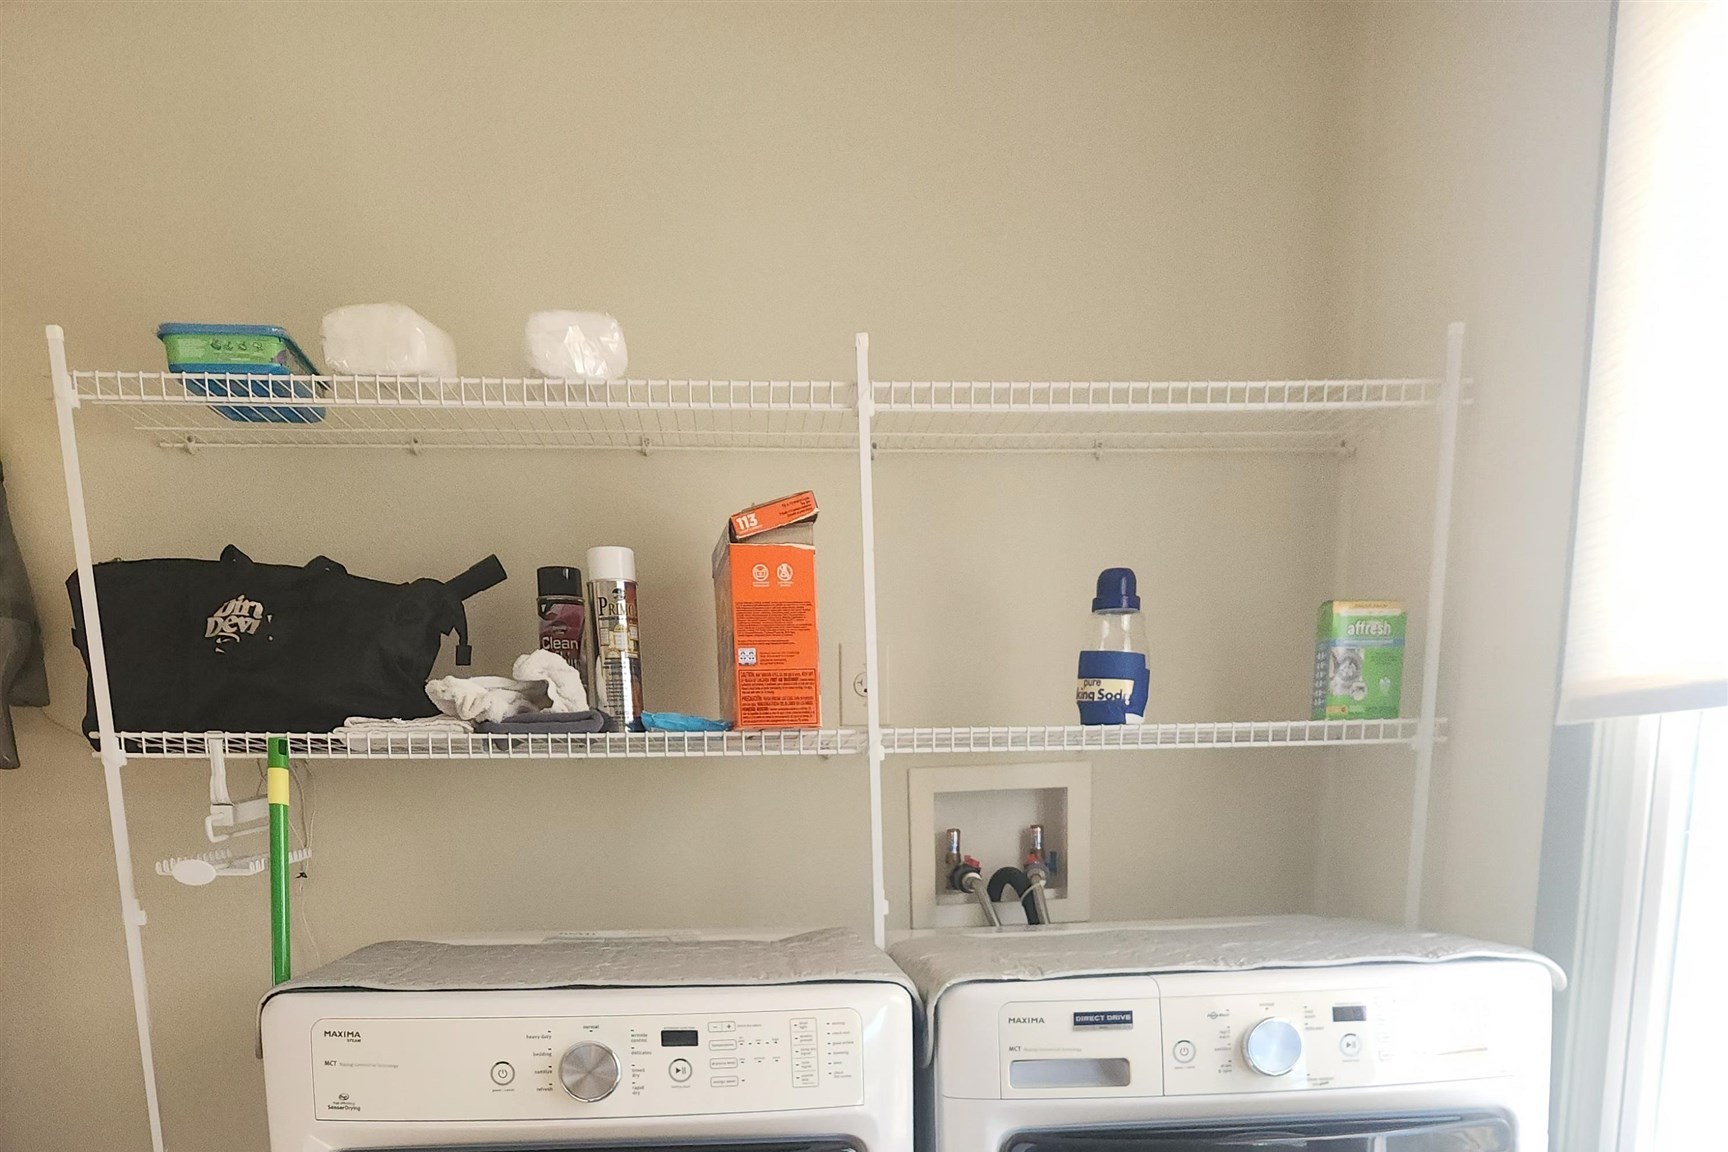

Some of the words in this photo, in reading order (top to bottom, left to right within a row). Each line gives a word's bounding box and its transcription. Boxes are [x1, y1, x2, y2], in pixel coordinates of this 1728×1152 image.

[735, 513, 758, 531] 113
[1347, 619, 1392, 637] affresh
[542, 637, 579, 650] Clean
[1083, 679, 1101, 688] pure
[1075, 1014, 1105, 1022] DIRECT
[1106, 1013, 1132, 1021] DRIVE
[323, 1030, 361, 1038] MAXIMA
